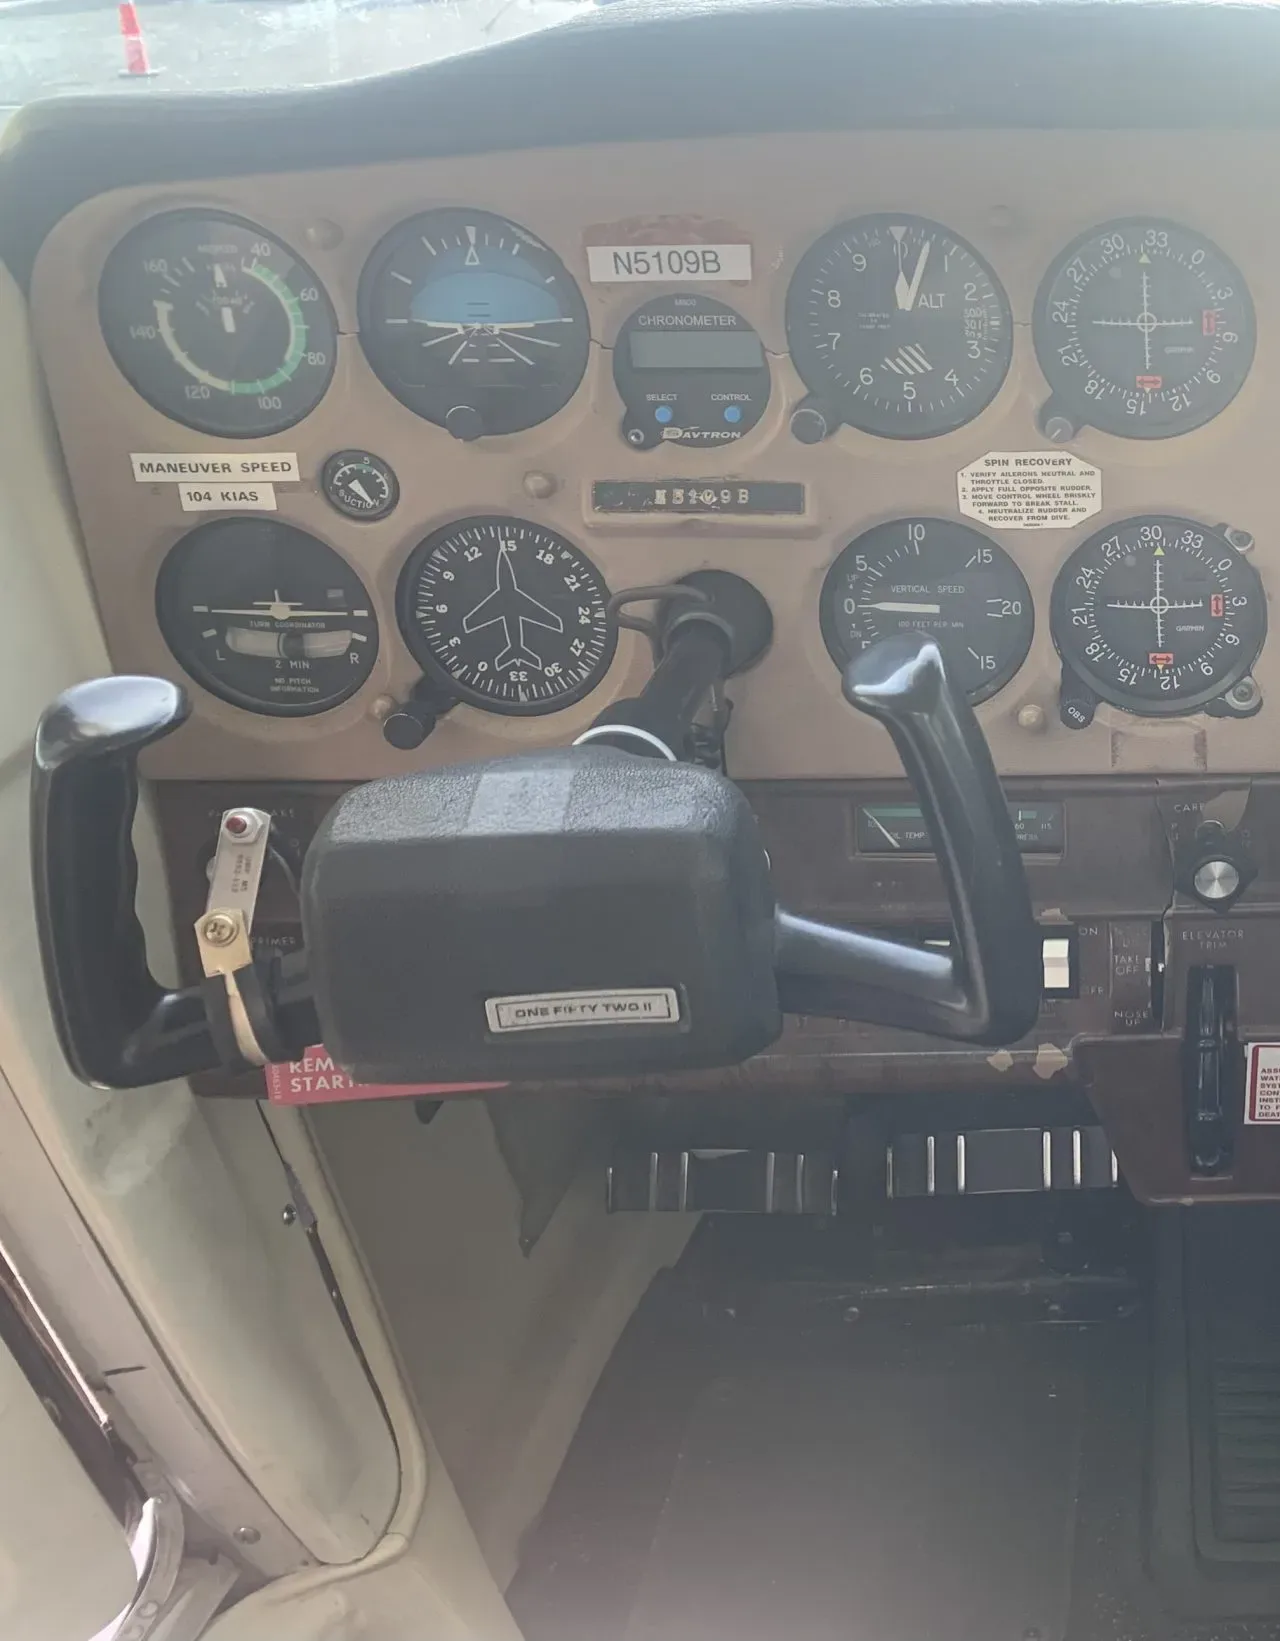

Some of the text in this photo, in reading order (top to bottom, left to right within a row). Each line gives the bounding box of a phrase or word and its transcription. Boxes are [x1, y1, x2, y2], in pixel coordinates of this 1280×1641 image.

[1100, 233, 1125, 255] 30
[1145, 229, 1168, 248] 33
[250, 243, 271, 256] 40
[1191, 249, 1205, 265] 0
[143, 259, 168, 273] 160
[613, 250, 721, 275] N5109B
[852, 254, 867, 272] 9
[1066, 257, 1088, 283] 27
[299, 288, 318, 301] 60
[827, 290, 841, 308] 8
[963, 282, 979, 301] 2
[1216, 287, 1233, 300] 3
[918, 293, 947, 309] ALT
[1052, 301, 1070, 324] 24
[638, 314, 737, 328] CHRONOMETER
[129, 326, 156, 339] 140
[827, 333, 841, 350] 7
[967, 340, 981, 360] 3
[1057, 345, 1078, 367] 21
[307, 353, 325, 365] 80
[859, 367, 874, 385] 6
[944, 369, 959, 387] 4
[185, 386, 210, 400] 120
[645, 393, 679, 401] SELECT
[710, 393, 752, 401] CONTROL
[903, 382, 917, 400] 5
[1084, 379, 1105, 400] 18
[258, 397, 281, 410] 100
[139, 462, 292, 473] MANEUVER SPEED
[984, 458, 1072, 467] SPIN RECOVERY
[186, 491, 258, 502] 104 KIAS
[907, 522, 926, 541] 10
[1140, 525, 1163, 541] 30
[1181, 529, 1204, 549] 33
[463, 546, 483, 562] 12
[1100, 536, 1122, 558] 27
[535, 549, 555, 566] 18
[855, 554, 868, 572] 5
[977, 547, 993, 564] 15
[1217, 558, 1232, 572] 0
[563, 575, 581, 592] 21
[1075, 566, 1096, 588] 24
[890, 585, 966, 594] VERTICAL SPEED
[843, 599, 856, 614] 0
[1000, 600, 1022, 616] 20
[1233, 595, 1248, 608] 3
[577, 606, 591, 625] 24
[1071, 606, 1089, 626] 21
[449, 636, 461, 647] 3
[569, 638, 586, 657] 27
[350, 653, 360, 664] R
[1084, 642, 1106, 663] 18
[478, 662, 488, 672] 0
[544, 662, 563, 677] 30
[979, 654, 996, 670] 15
[509, 671, 528, 682] 33
[1117, 667, 1139, 687] 15
[1159, 675, 1181, 692] 12
[1067, 706, 1087, 724] OBS
[1182, 929, 1244, 940] ELEVATOR
[515, 1004, 639, 1018] ONE FIFTY TWO
